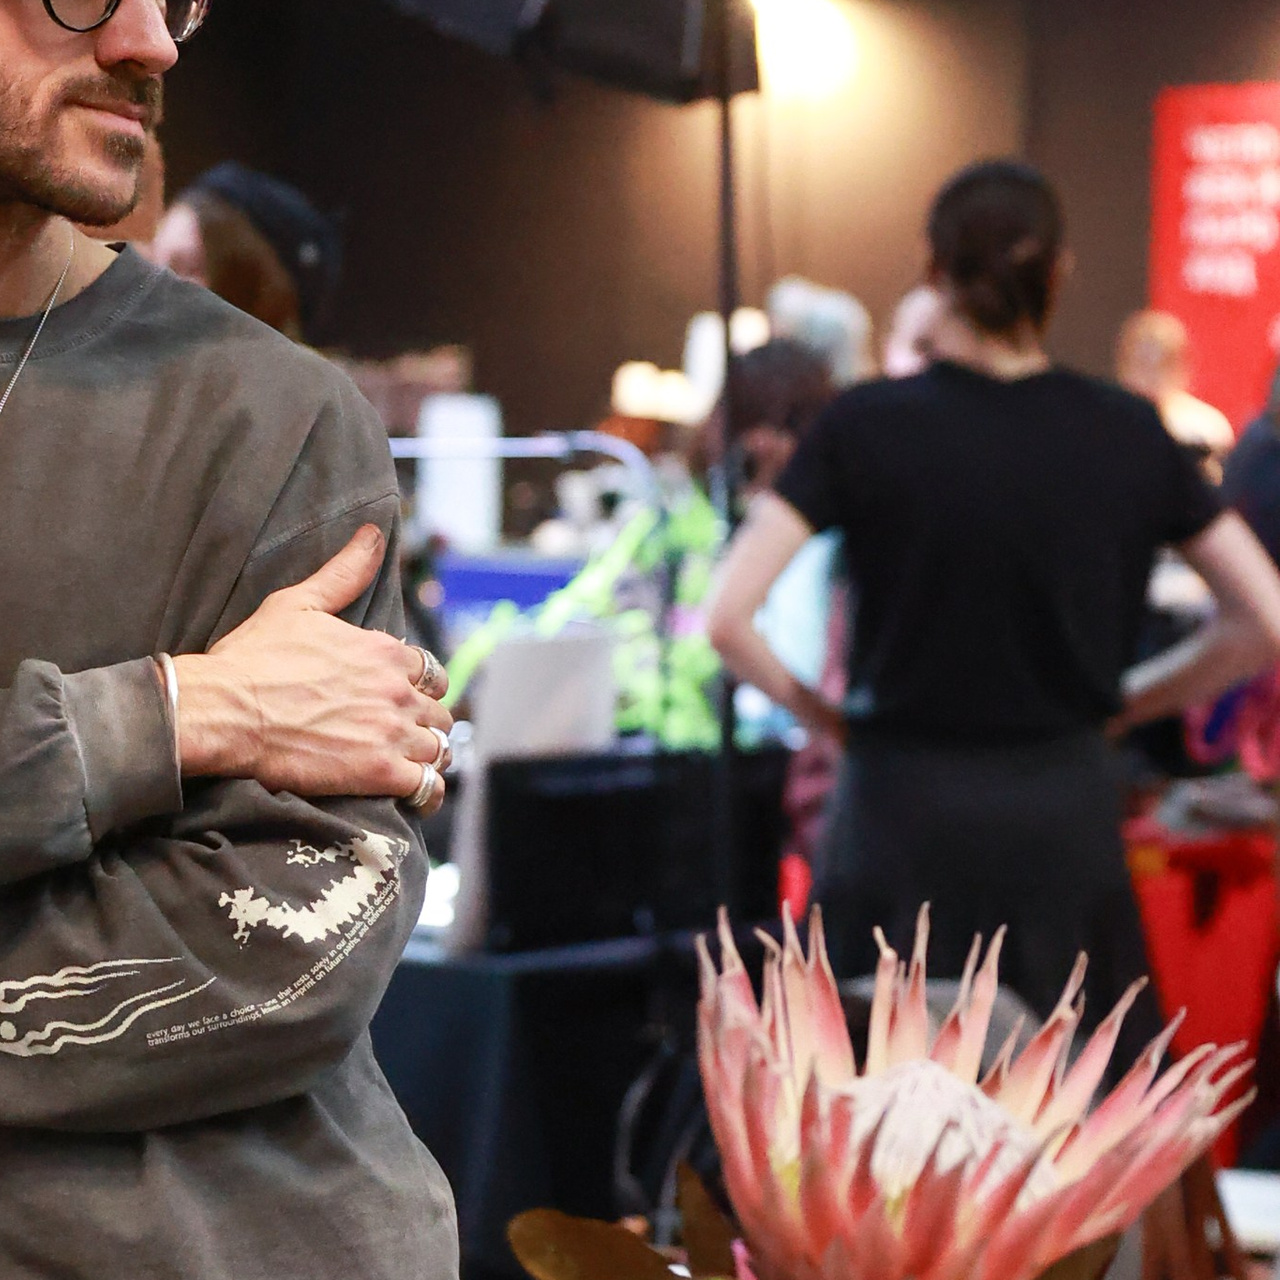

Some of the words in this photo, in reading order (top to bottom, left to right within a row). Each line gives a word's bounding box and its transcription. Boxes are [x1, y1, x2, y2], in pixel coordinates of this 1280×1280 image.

[146, 1028, 168, 1039] every
[171, 1024, 185, 1034] day
[188, 1020, 200, 1029] we
[202, 1015, 220, 1025] face
[230, 1004, 255, 1018] choice
[278, 986, 293, 1000] that
[292, 973, 310, 988] rests
[310, 956, 330, 975] solely
[336, 939, 346, 950] our
[362, 903, 375, 920] each
[374, 880, 395, 905] decision
[147, 1031, 190, 1046] transforms
[192, 1026, 205, 1036] our
[207, 1010, 262, 1032] surroundings,
[280, 998, 291, 1007] an
[290, 978, 316, 1001] imprint
[315, 970, 326, 980] on
[324, 953, 345, 973] future
[342, 937, 361, 957] paths,
[358, 925, 370, 938] and
[367, 903, 387, 926] defines
[384, 893, 395, 905] our
